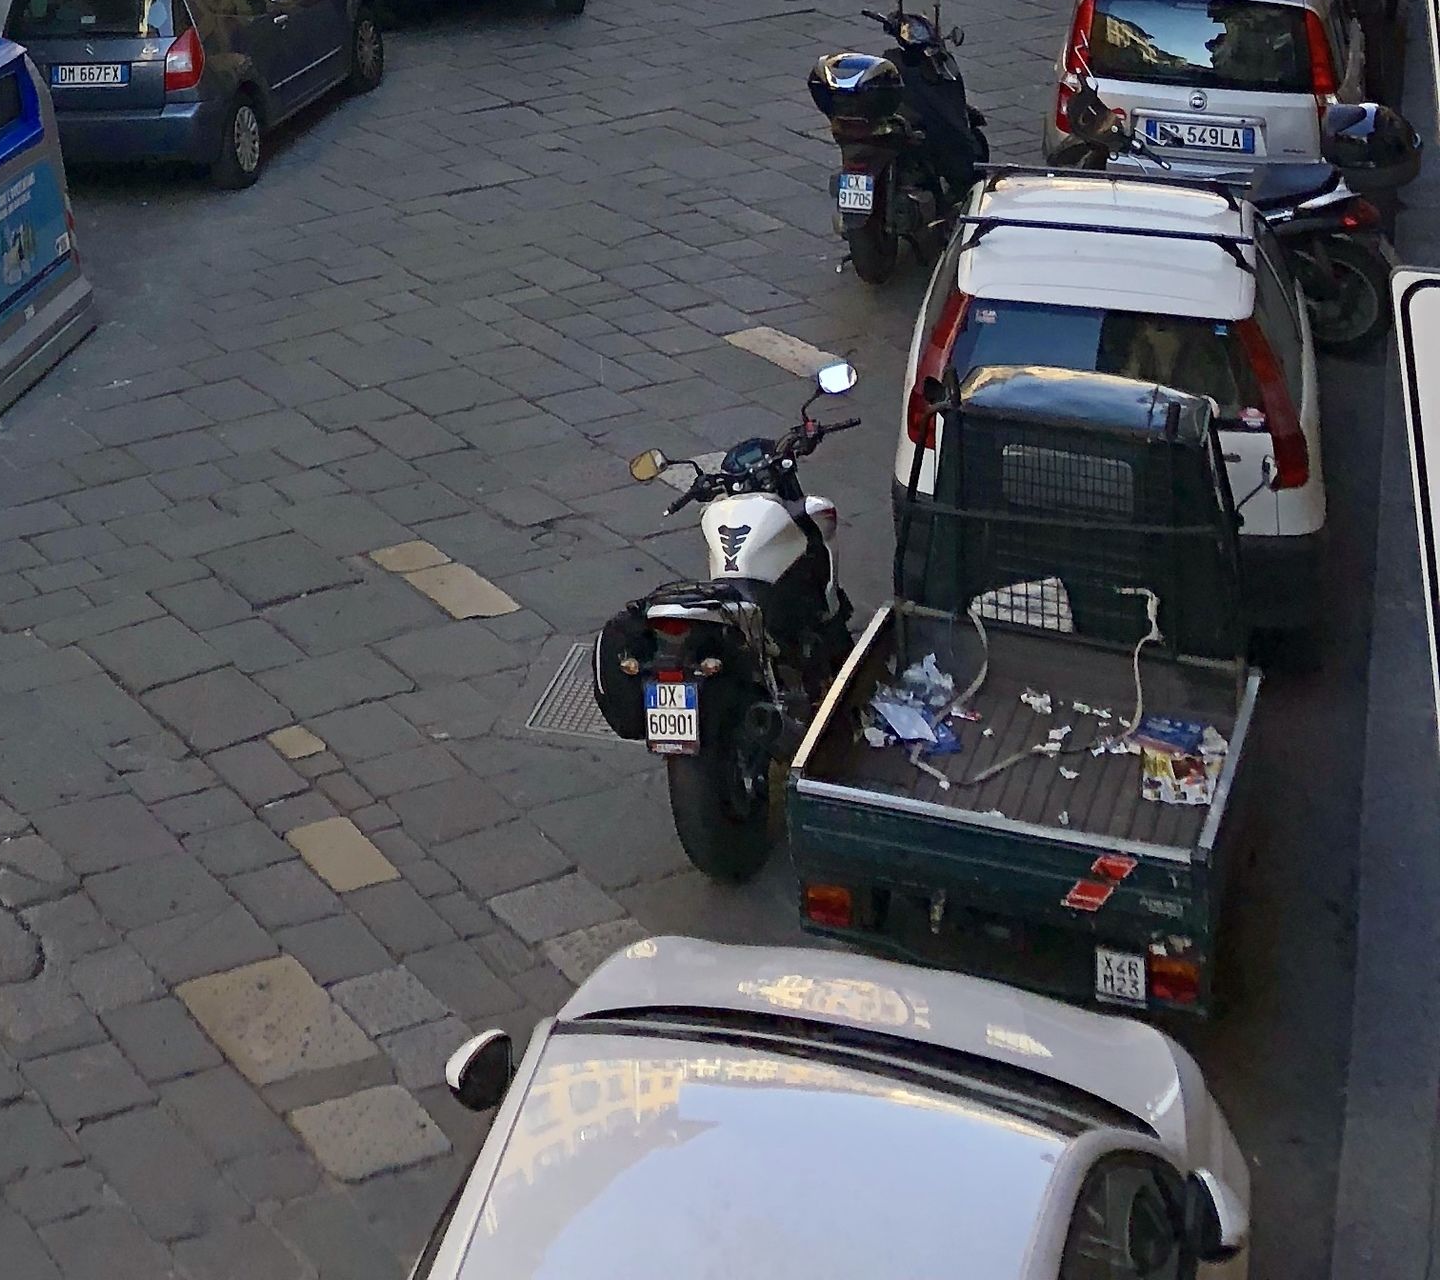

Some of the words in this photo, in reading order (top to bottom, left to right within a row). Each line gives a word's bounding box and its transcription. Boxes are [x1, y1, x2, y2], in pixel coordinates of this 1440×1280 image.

[60, 67, 75, 81] DM
[80, 66, 119, 81] 667FX
[1187, 126, 1241, 148] 549LA
[848, 176, 860, 189] CX
[659, 686, 677, 706] DX
[650, 714, 693, 735] 60901
